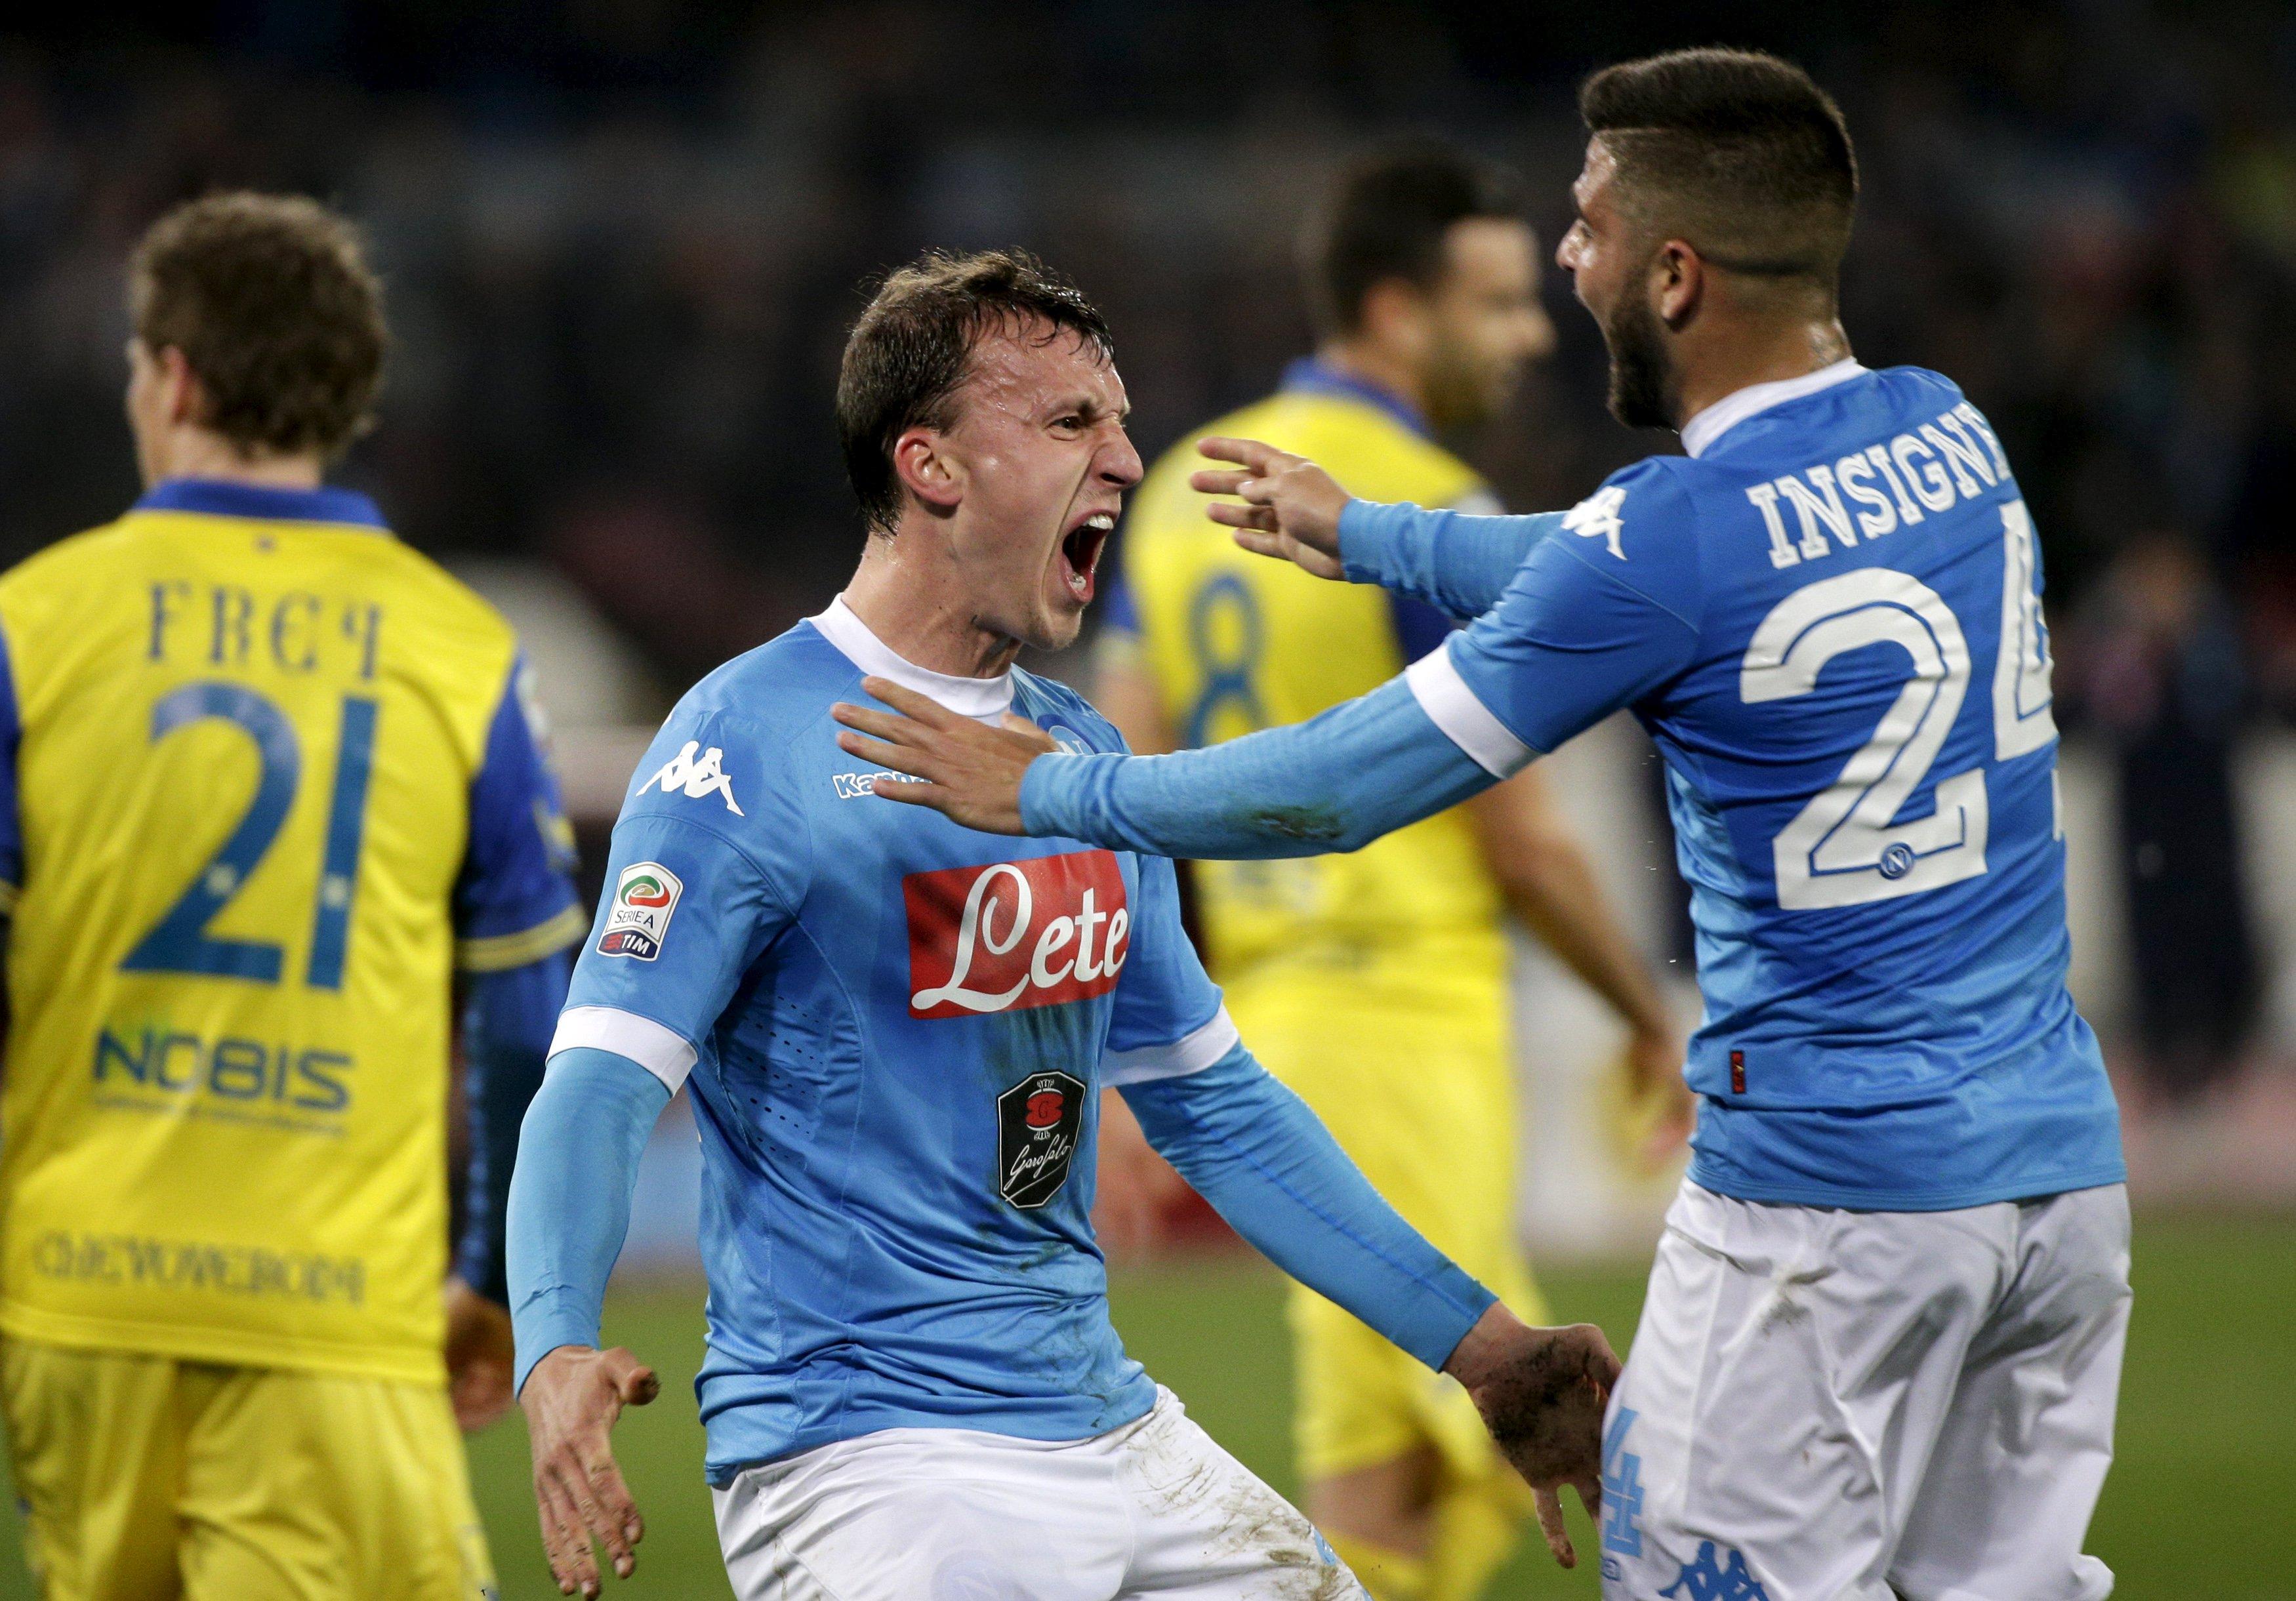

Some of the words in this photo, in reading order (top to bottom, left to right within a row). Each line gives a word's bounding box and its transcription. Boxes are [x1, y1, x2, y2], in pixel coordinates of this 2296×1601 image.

[119, 679, 380, 991] 21
[615, 910, 644, 923] SERIE
[643, 914, 653, 929] A
[621, 934, 650, 955] TIM
[911, 863, 1129, 1012] Lete
[92, 1025, 356, 1112] NOBIS
